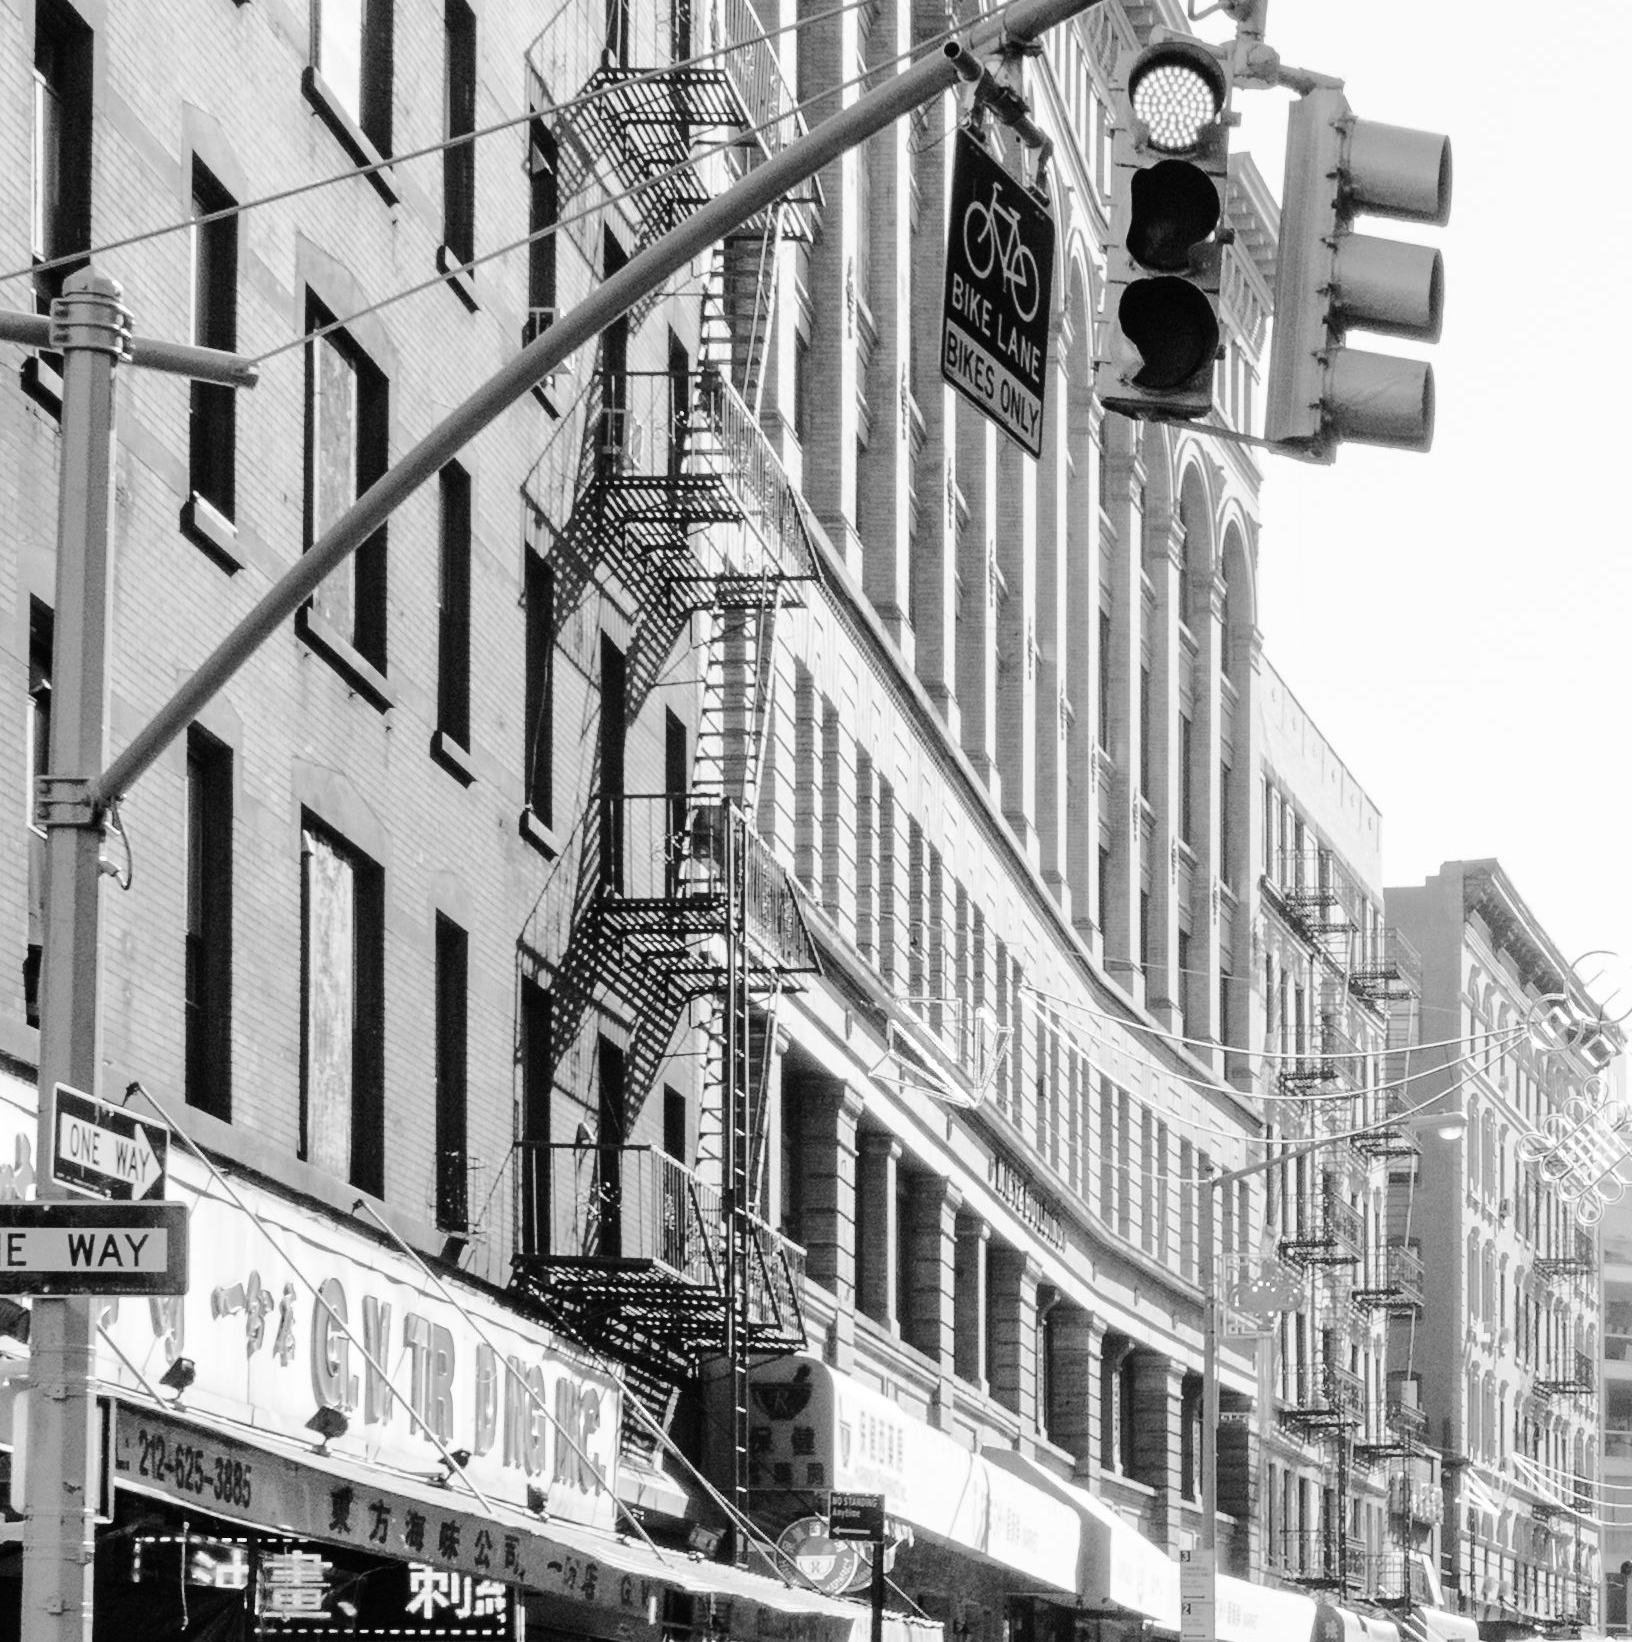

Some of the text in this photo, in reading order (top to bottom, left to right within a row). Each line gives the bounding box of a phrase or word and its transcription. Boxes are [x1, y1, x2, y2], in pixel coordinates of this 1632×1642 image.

[952, 272, 1041, 384] BIKE LANE
[946, 330, 1039, 438] BIKES ONLY
[70, 1123, 100, 1165] ONE
[115, 1140, 150, 1183] WAY
[0, 1233, 149, 1266] E WAY
